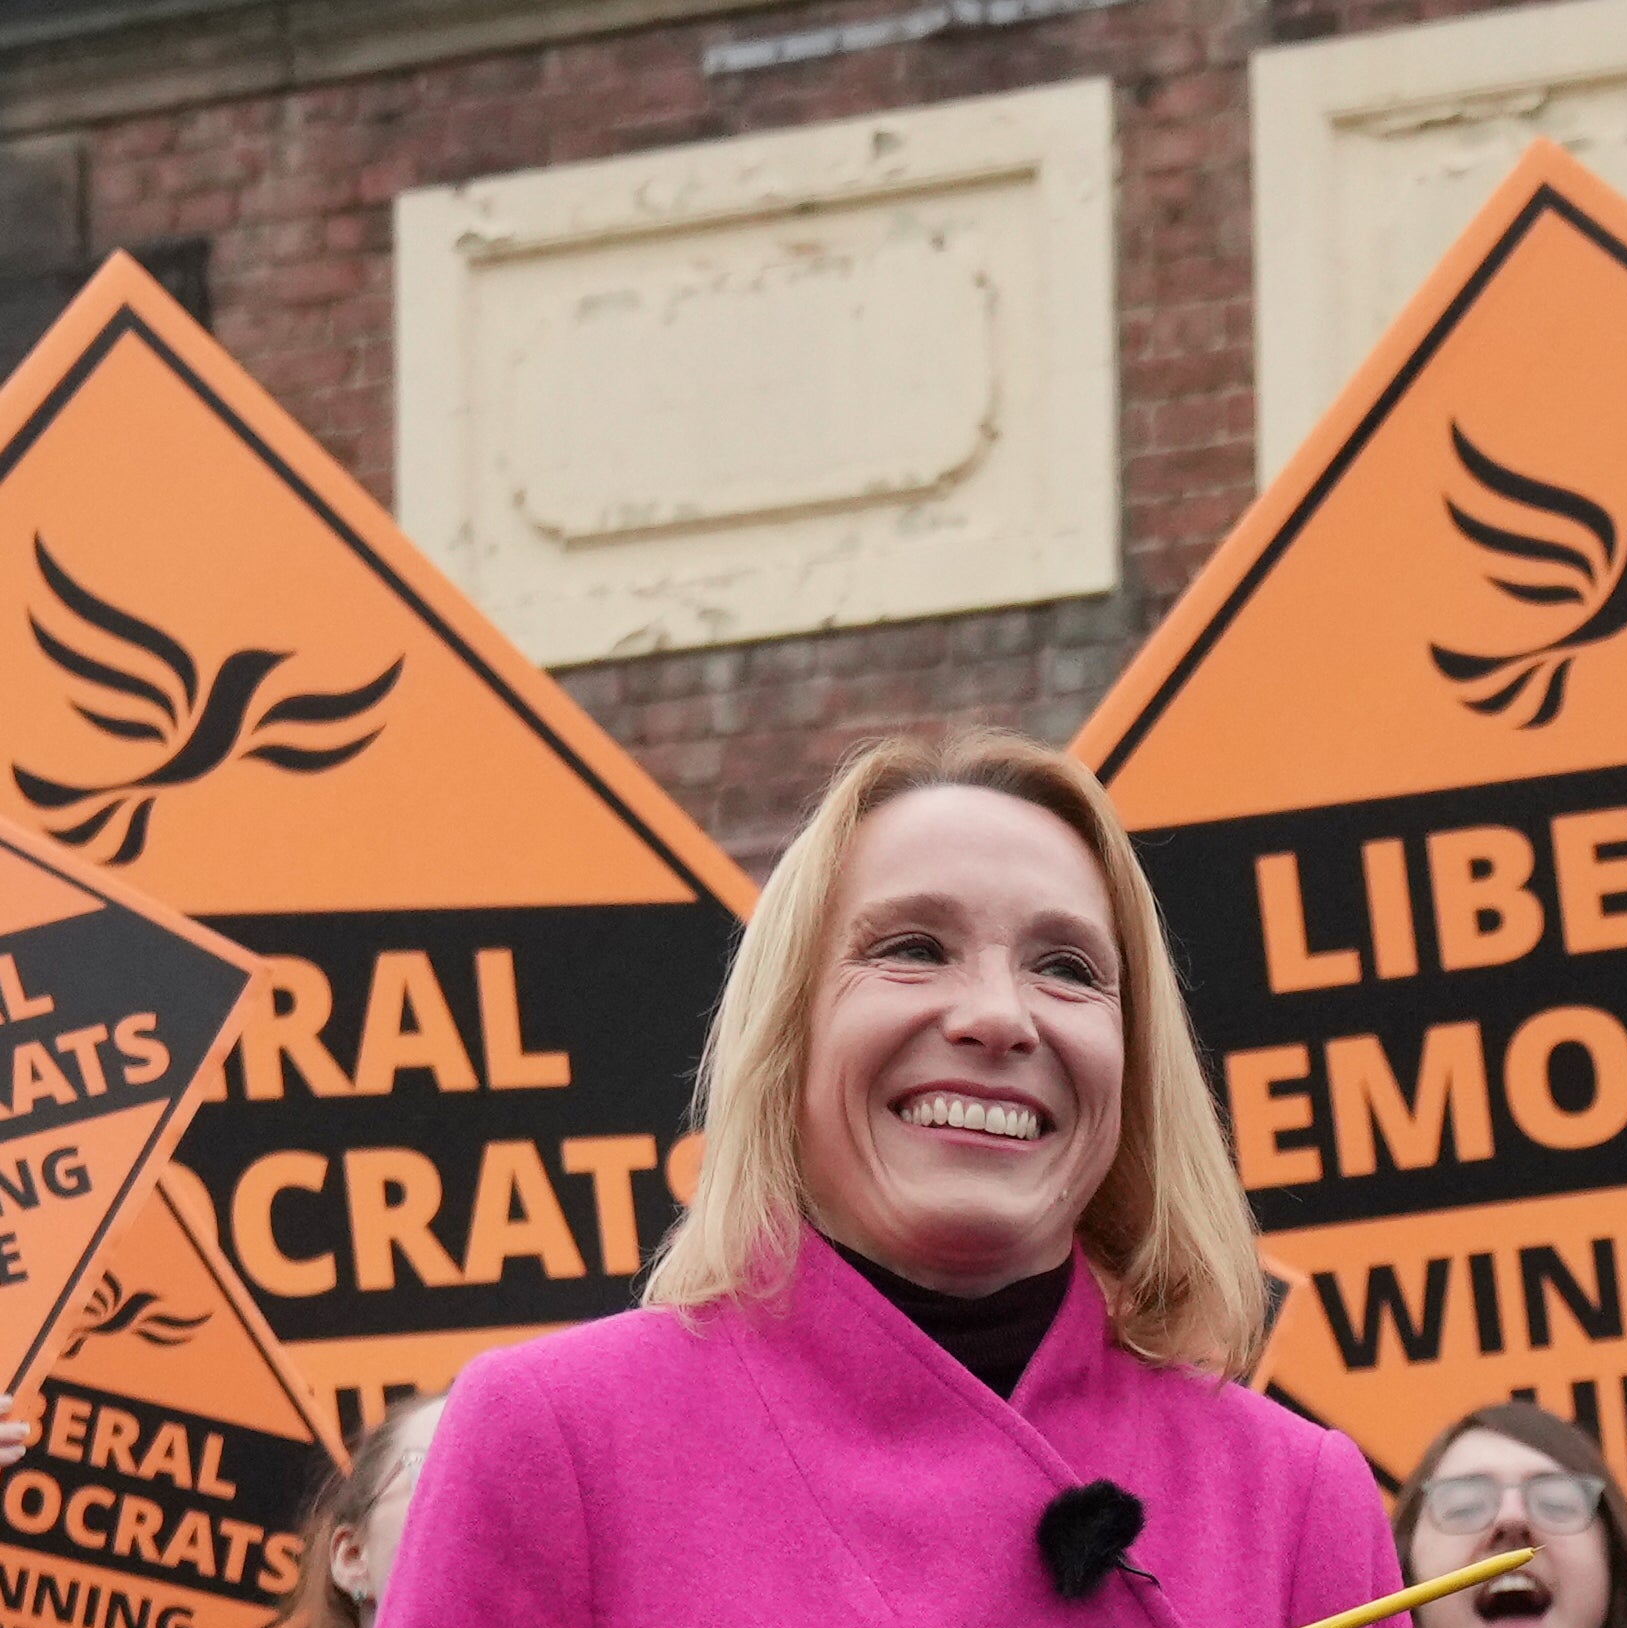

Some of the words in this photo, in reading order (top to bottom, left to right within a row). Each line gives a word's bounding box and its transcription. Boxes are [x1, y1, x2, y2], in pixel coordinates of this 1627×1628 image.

[0, 1011, 172, 1123] ATS
[201, 946, 571, 1103] RAL
[26, 1388, 237, 1500] ERAL
[3, 1468, 307, 1597] OCRATS
